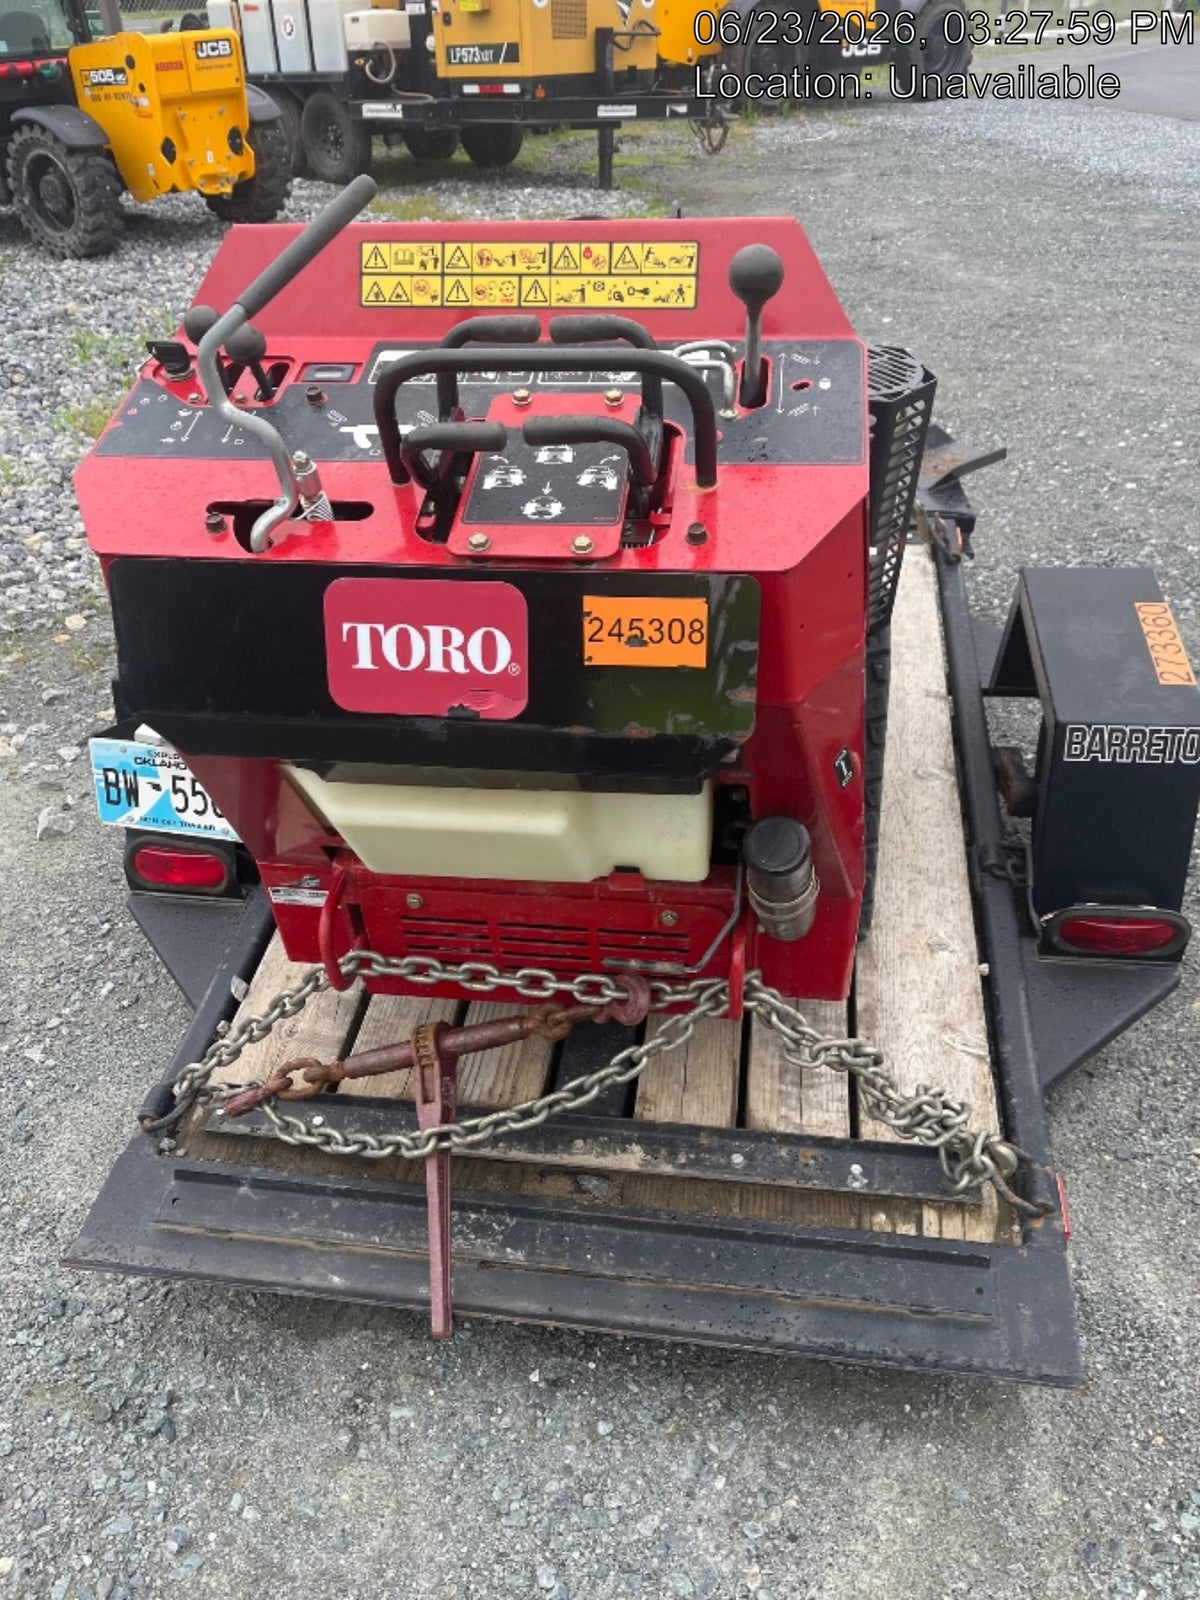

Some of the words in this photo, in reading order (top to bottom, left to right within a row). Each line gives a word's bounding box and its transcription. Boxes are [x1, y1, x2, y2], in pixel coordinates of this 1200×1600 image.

[197, 40, 231, 57] JCB
[342, 621, 511, 675] TORO
[587, 617, 705, 645] 245308
[1138, 604, 1193, 683] 273360
[1063, 724, 1200, 764] BARRETO
[103, 767, 139, 808] BW
